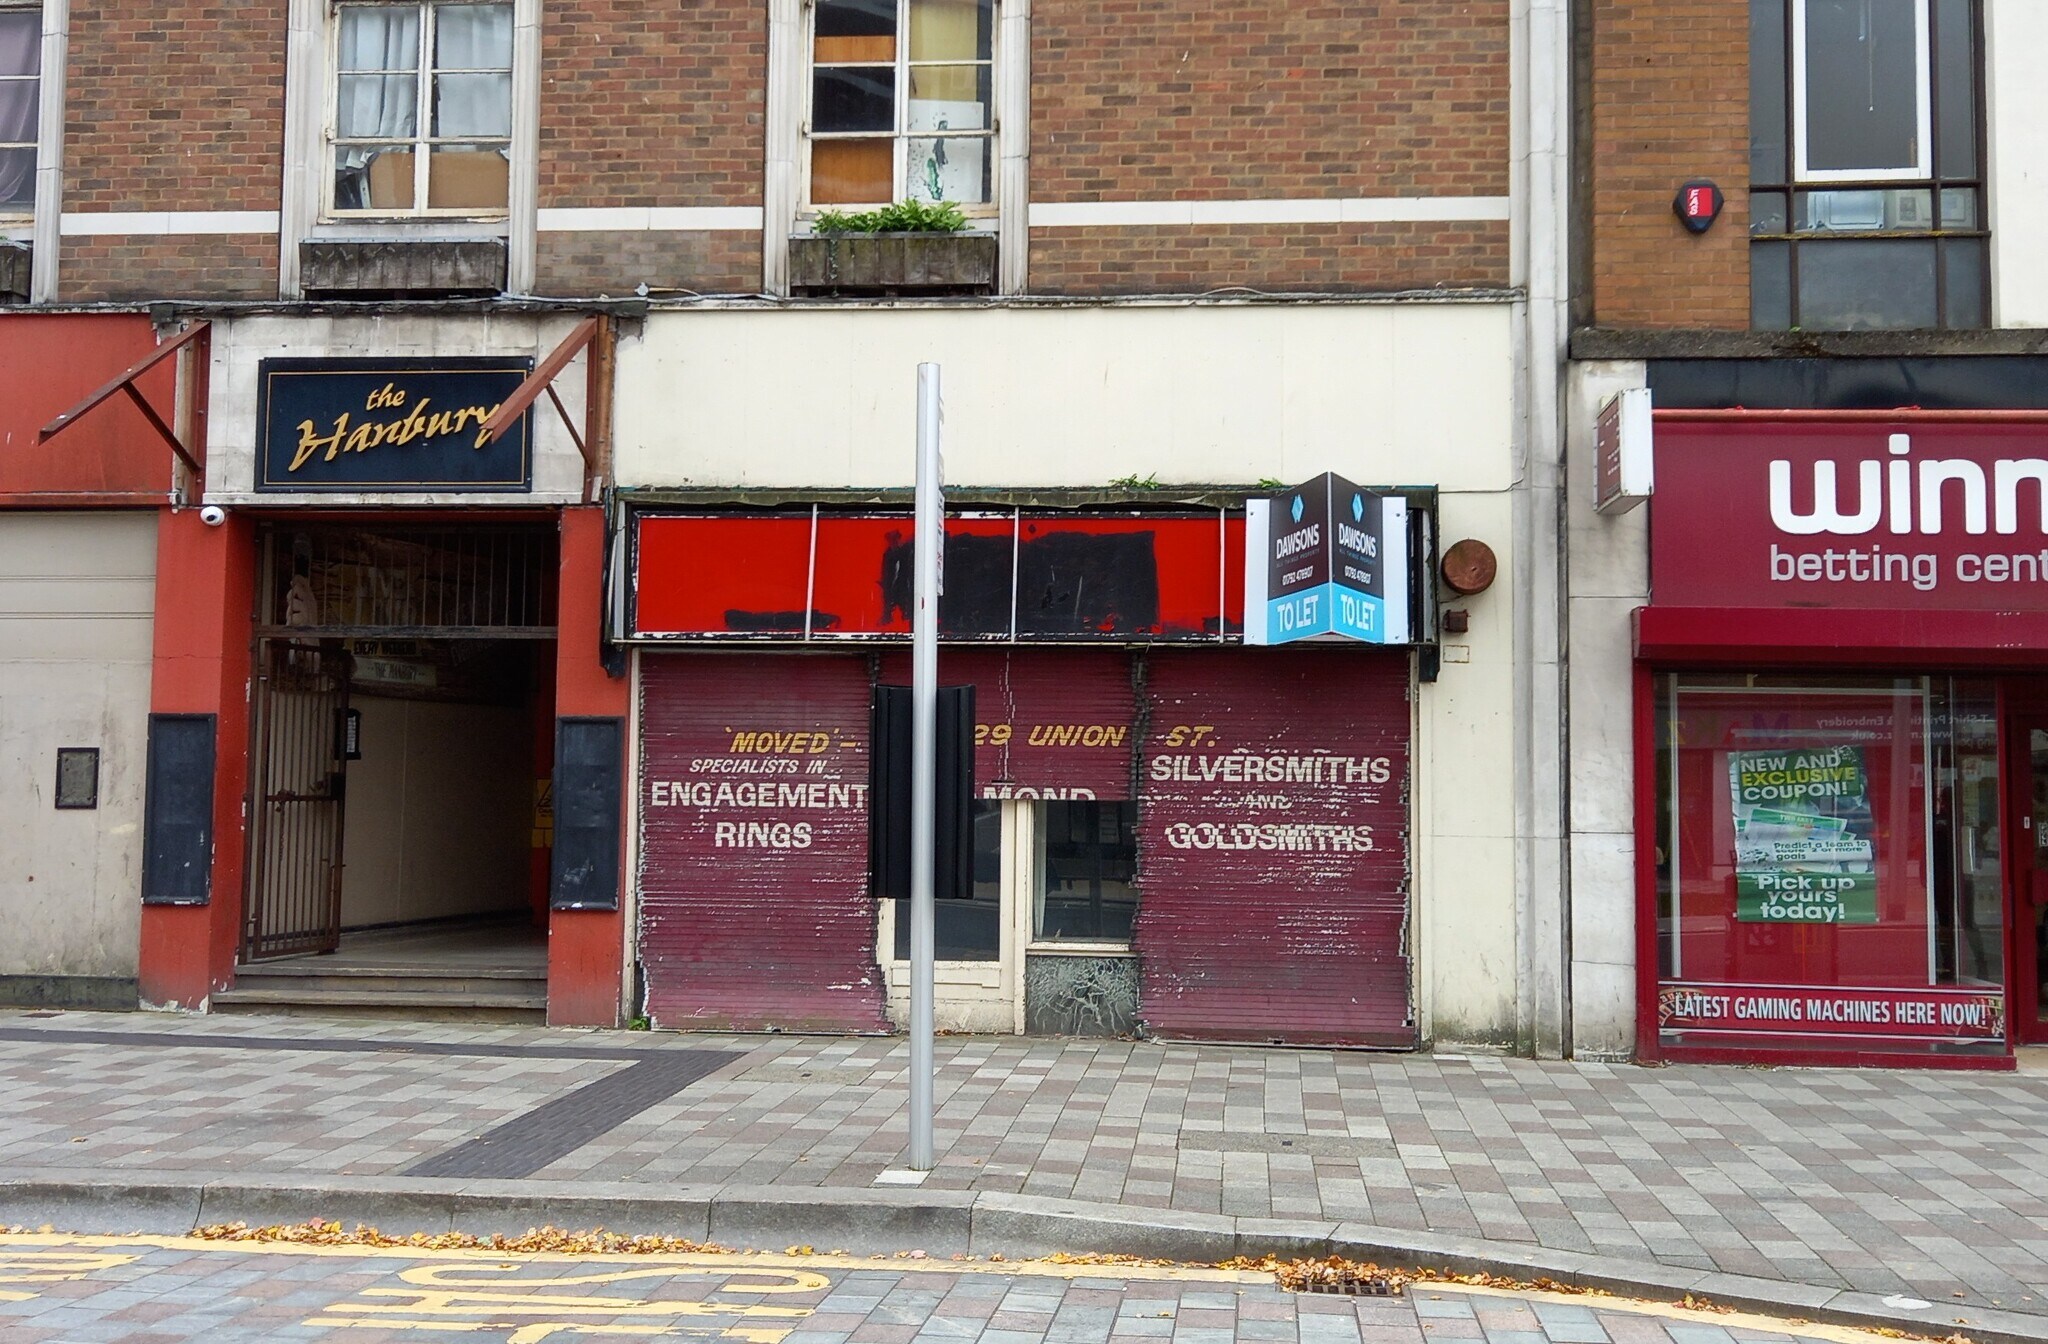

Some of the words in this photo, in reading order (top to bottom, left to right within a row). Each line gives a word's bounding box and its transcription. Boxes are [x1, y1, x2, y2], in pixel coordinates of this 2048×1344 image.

[365, 382, 406, 411] the
[288, 398, 500, 472] Hanbury
[1276, 523, 1320, 560] DAWSONS
[1338, 522, 1377, 558] DAWSONS
[1770, 544, 1937, 592] betting
[1277, 603, 1293, 632] TO
[1296, 594, 1319, 629] LET
[1340, 594, 1354, 626] TO
[1355, 601, 1376, 632] LET
[1028, 725, 1127, 747] UNION
[1165, 726, 1216, 748] ST.
[689, 758, 799, 774] SPECIALISTS
[805, 760, 828, 774] IN
[1150, 755, 1391, 784] SILVERSMITHS
[1740, 756, 1787, 773] NEW
[1794, 753, 1841, 769] AND
[1741, 767, 1856, 787] EXCLUSIVE
[651, 781, 869, 808] ENGAGEMENT
[1246, 795, 1294, 810] AND
[1744, 782, 1848, 801] COUPON!
[715, 822, 812, 848] RINGS
[1165, 823, 1374, 851] GOLDSMITHS
[1774, 842, 1813, 850] Predict
[1776, 853, 1806, 863] goals
[1757, 875, 1812, 890] Pick
[1822, 877, 1855, 892] up
[1768, 890, 1836, 905] yours
[1760, 902, 1845, 923] today!
[1675, 996, 1730, 1018] LATEST
[1735, 997, 1801, 1020] GAMING
[1807, 999, 1890, 1023] MACHINES
[1895, 1001, 1936, 1024] HERE
[1940, 1003, 1986, 1026] NOW!
